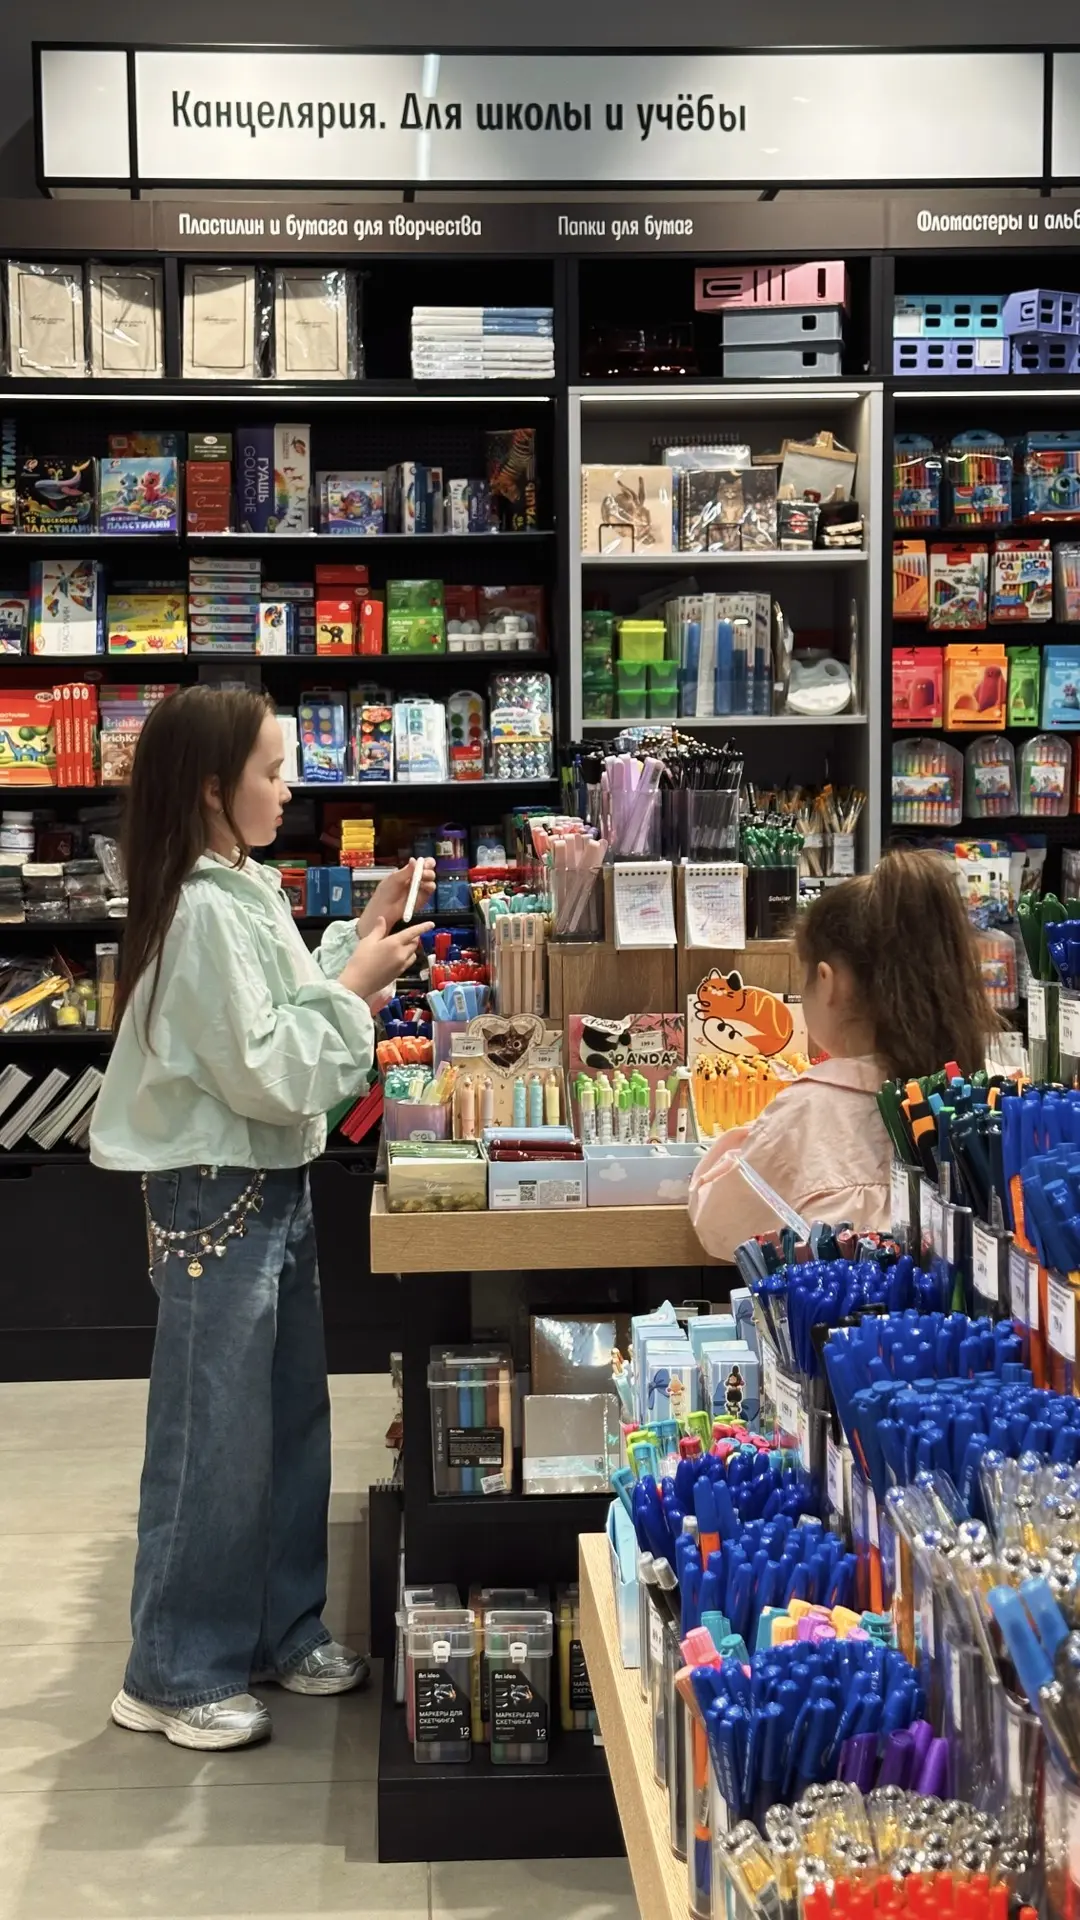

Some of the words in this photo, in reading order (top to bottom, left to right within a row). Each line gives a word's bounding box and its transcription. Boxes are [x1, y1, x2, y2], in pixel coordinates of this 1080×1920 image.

[172, 90, 386, 138] Канцелярия.
[401, 93, 462, 130] Для
[476, 102, 592, 132] школы
[606, 103, 623, 132] и
[637, 93, 746, 141] учёбы
[178, 213, 265, 236] Пластилин
[270, 218, 281, 236] и
[286, 213, 348, 241] бумага
[354, 219, 383, 241] для
[388, 214, 482, 241] творчества
[557, 215, 605, 236] Папки
[611, 220, 639, 241] для
[645, 214, 693, 241] бумаг
[916, 209, 1023, 236] Фломастеры
[1028, 214, 1039, 230] и
[243, 445, 257, 513] GOUACHE
[257, 457, 270, 503] ГУАШЬ
[525, 482, 537, 525] УАШЬ
[23, 524, 94, 534] ПЛАСТИЛИН
[106, 520, 171, 530] ПЛАСТИЛИН
[106, 718, 144, 728] ErichKr
[101, 733, 139, 742] ErichKr
[612, 1052, 671, 1067] PANDA
[459, 1726, 470, 1736] 12
[536, 1728, 546, 1737] 12
